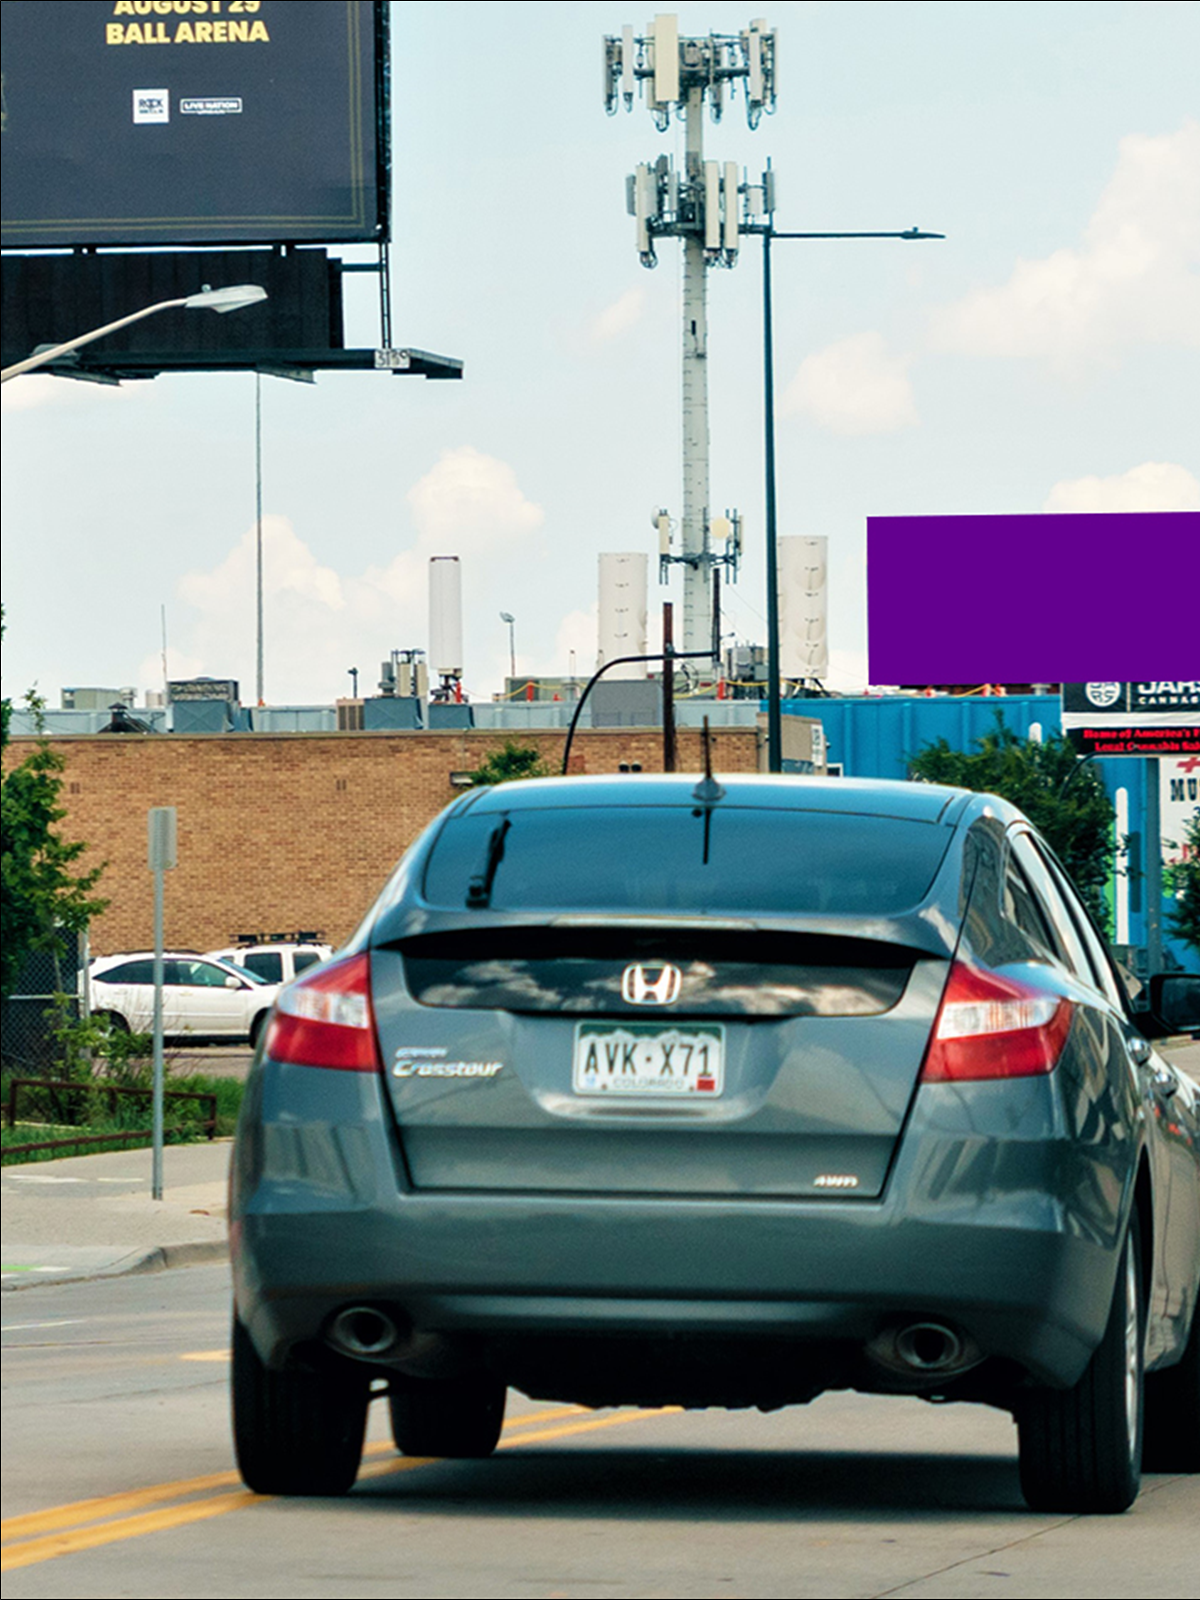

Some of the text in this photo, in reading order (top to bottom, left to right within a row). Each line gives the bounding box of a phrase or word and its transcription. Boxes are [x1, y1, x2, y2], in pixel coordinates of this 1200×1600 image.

[113, 1, 261, 15] AUGUST 29
[106, 20, 270, 44] BALL ARENA
[393, 1059, 504, 1077] Crosstour
